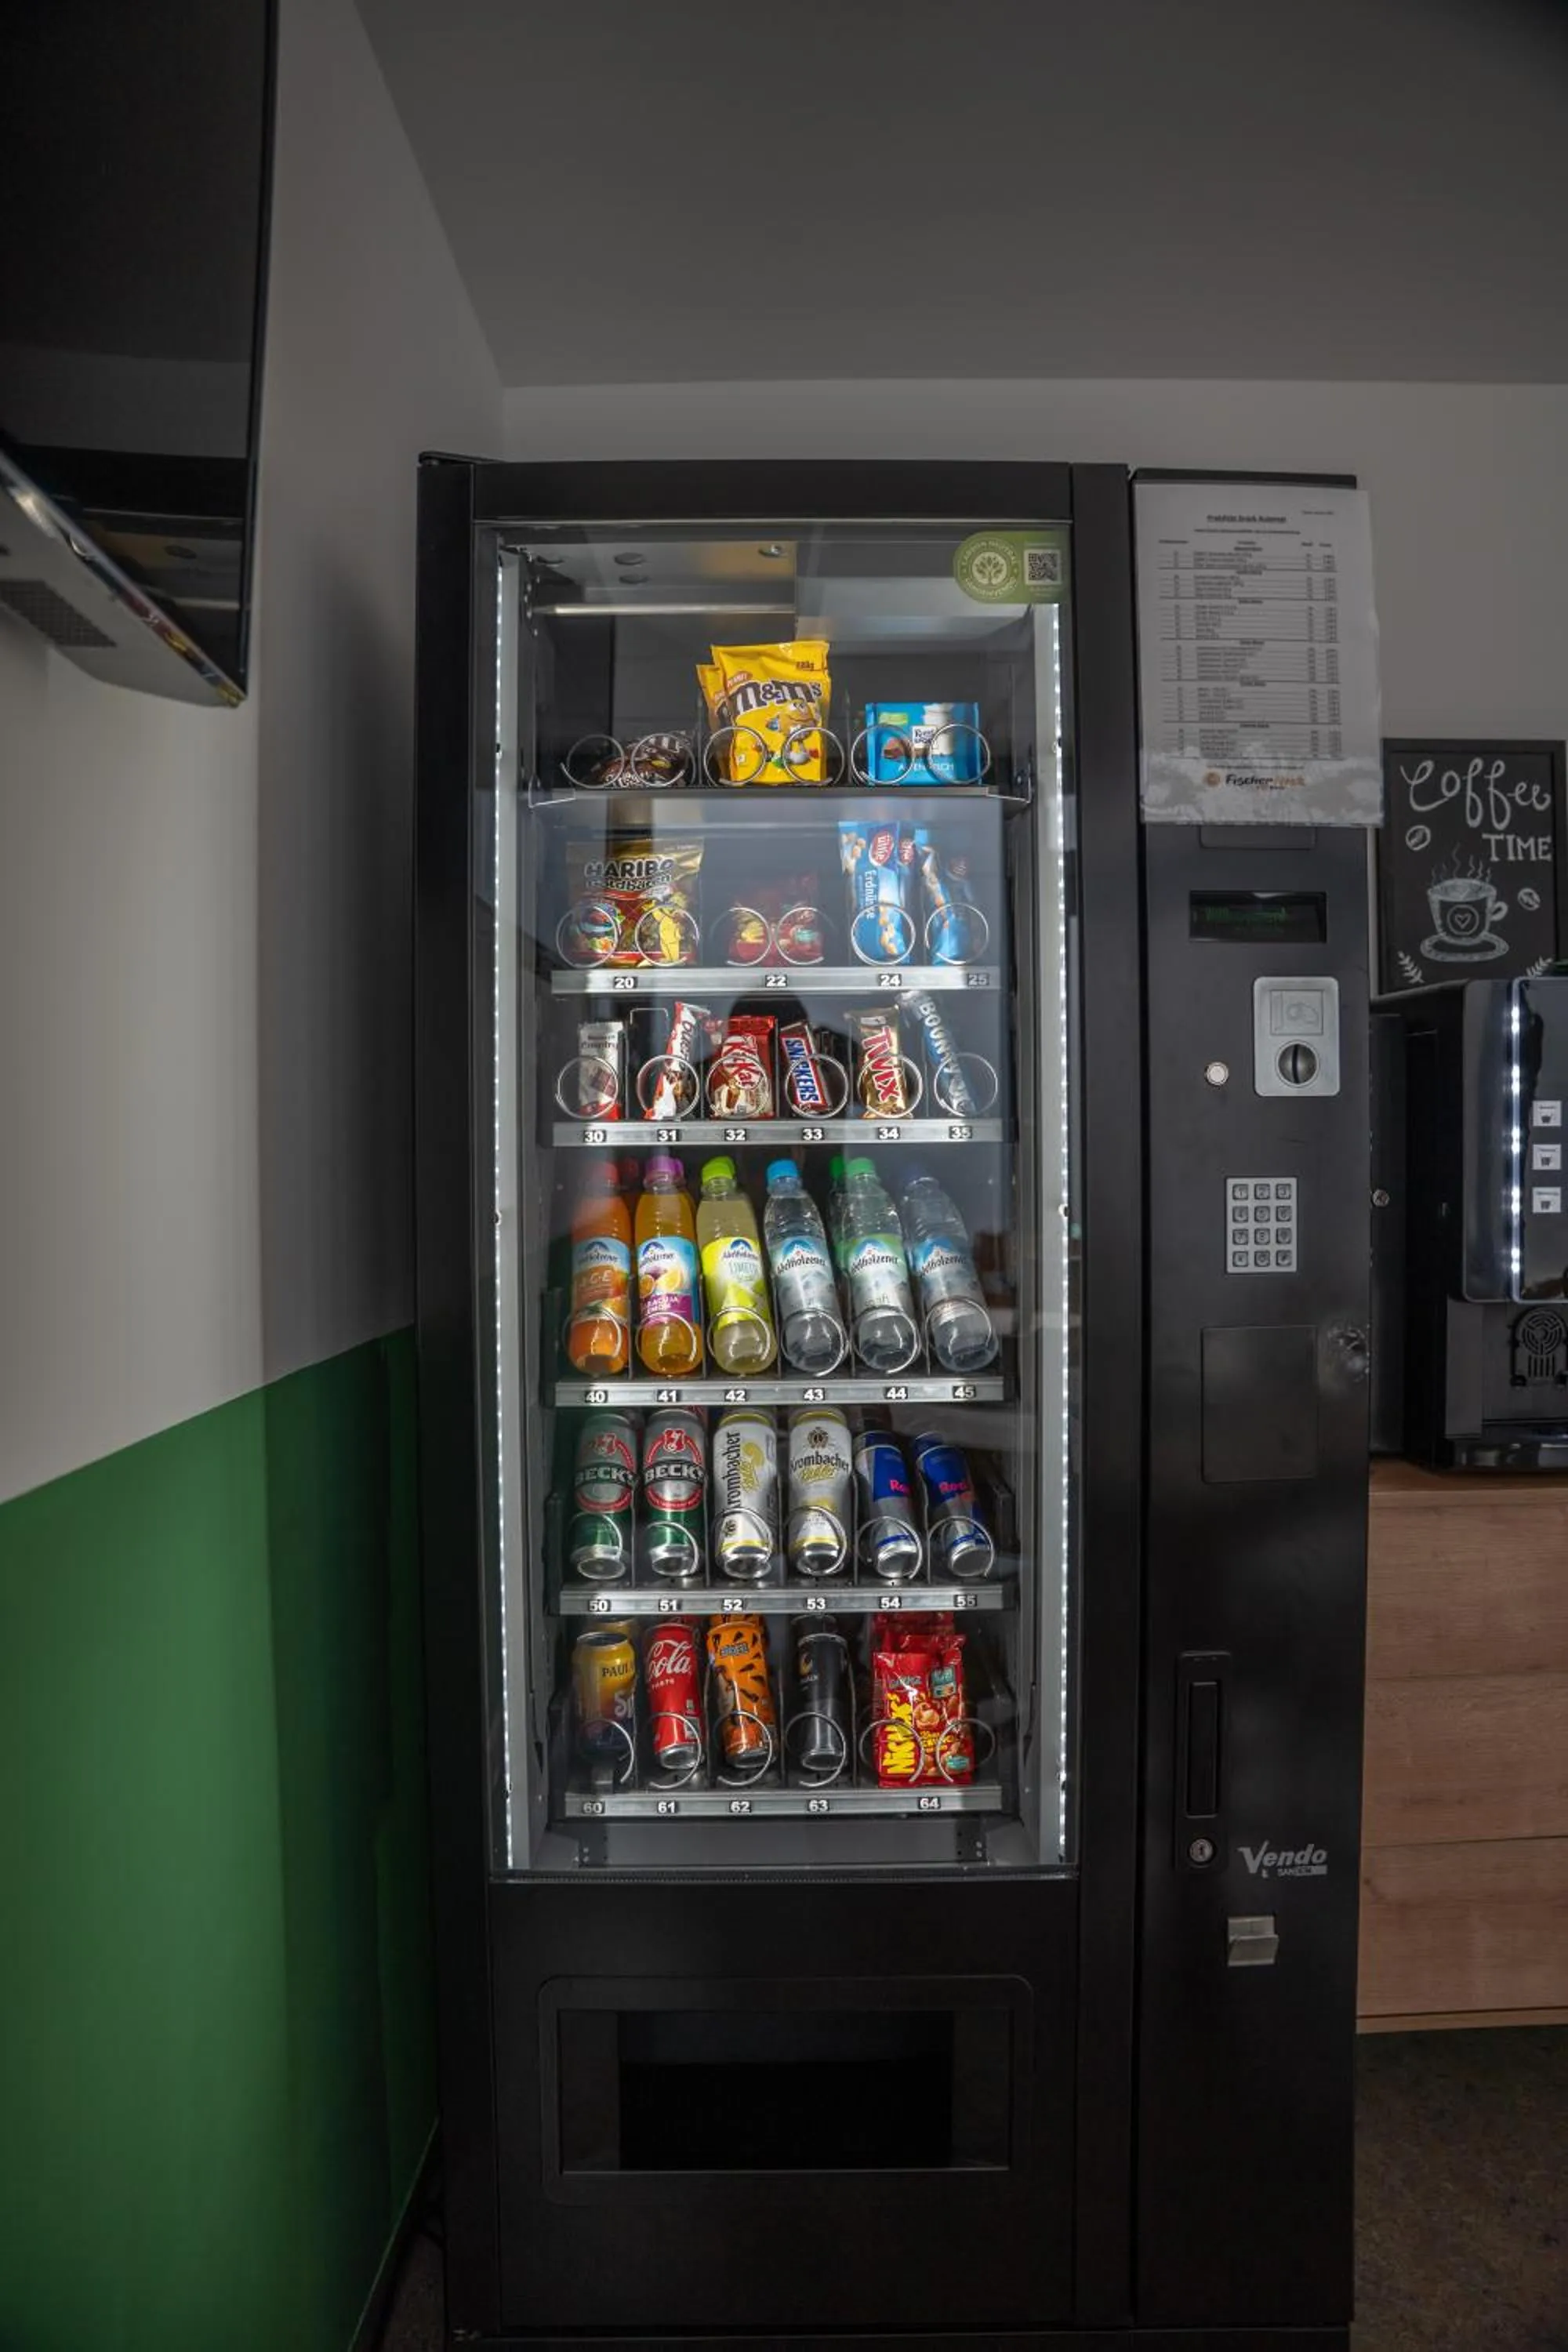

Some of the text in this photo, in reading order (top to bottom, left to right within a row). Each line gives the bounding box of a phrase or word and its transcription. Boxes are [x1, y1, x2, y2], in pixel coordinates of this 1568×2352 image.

[1400, 757, 1552, 831] Coffee
[1482, 833, 1552, 862] TIME
[584, 858, 675, 879] HARIBO
[614, 976, 634, 989] 20
[765, 975, 787, 987] 22
[880, 974, 901, 986] 24
[968, 974, 987, 986] 25
[584, 1131, 604, 1143] 30
[658, 1129, 677, 1142] 31
[724, 1129, 746, 1142] 32
[802, 1128, 823, 1141] 33
[878, 1127, 899, 1140] 34
[950, 1127, 971, 1139] 35
[586, 1391, 605, 1403] 40
[658, 1390, 677, 1403] 41
[724, 1389, 746, 1402] 42
[803, 1388, 824, 1401] 43
[886, 1387, 907, 1399] 44
[954, 1386, 975, 1399] 45
[589, 1599, 608, 1612] 50
[659, 1599, 678, 1612] 51
[723, 1599, 743, 1611] 52
[806, 1597, 826, 1610] 53
[880, 1596, 901, 1609] 54
[956, 1595, 976, 1607] 55
[583, 1802, 603, 1814] 60
[658, 1801, 677, 1814] 61
[730, 1800, 751, 1813] 62
[808, 1799, 829, 1812] 63
[919, 1798, 939, 1810] 64
[1236, 1839, 1328, 1875] Vendo
